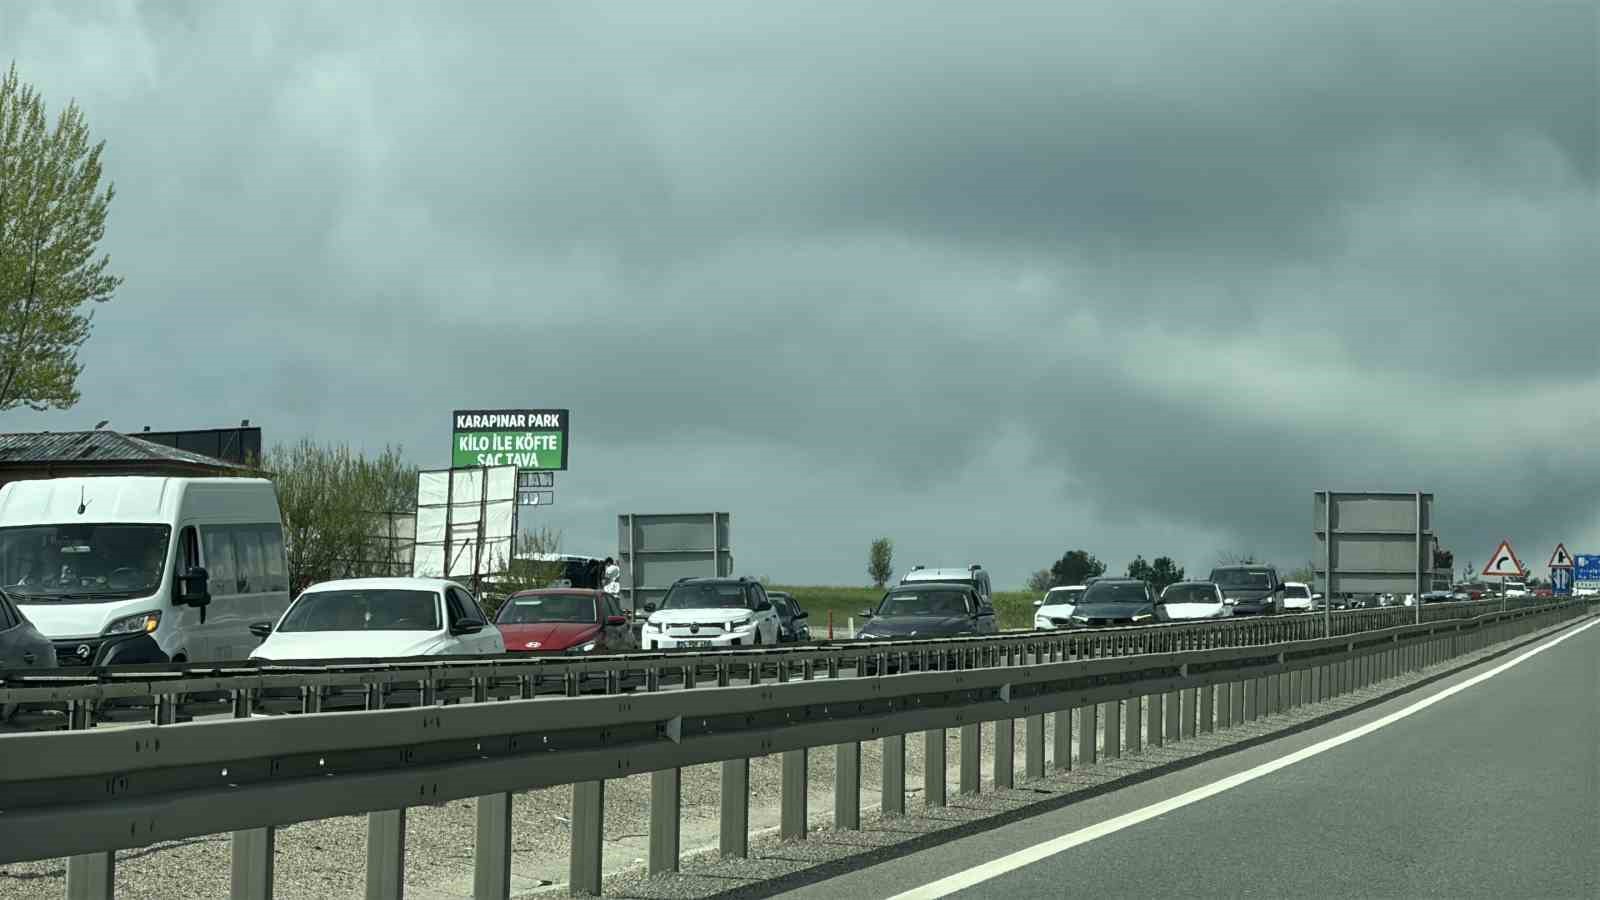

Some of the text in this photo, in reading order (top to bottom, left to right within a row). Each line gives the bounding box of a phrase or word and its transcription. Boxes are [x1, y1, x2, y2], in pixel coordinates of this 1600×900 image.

[457, 413, 560, 428] KARAPINAR PARK
[459, 432, 557, 451] KİLO İLE KÖFTE
[506, 452, 539, 467] TAVA
